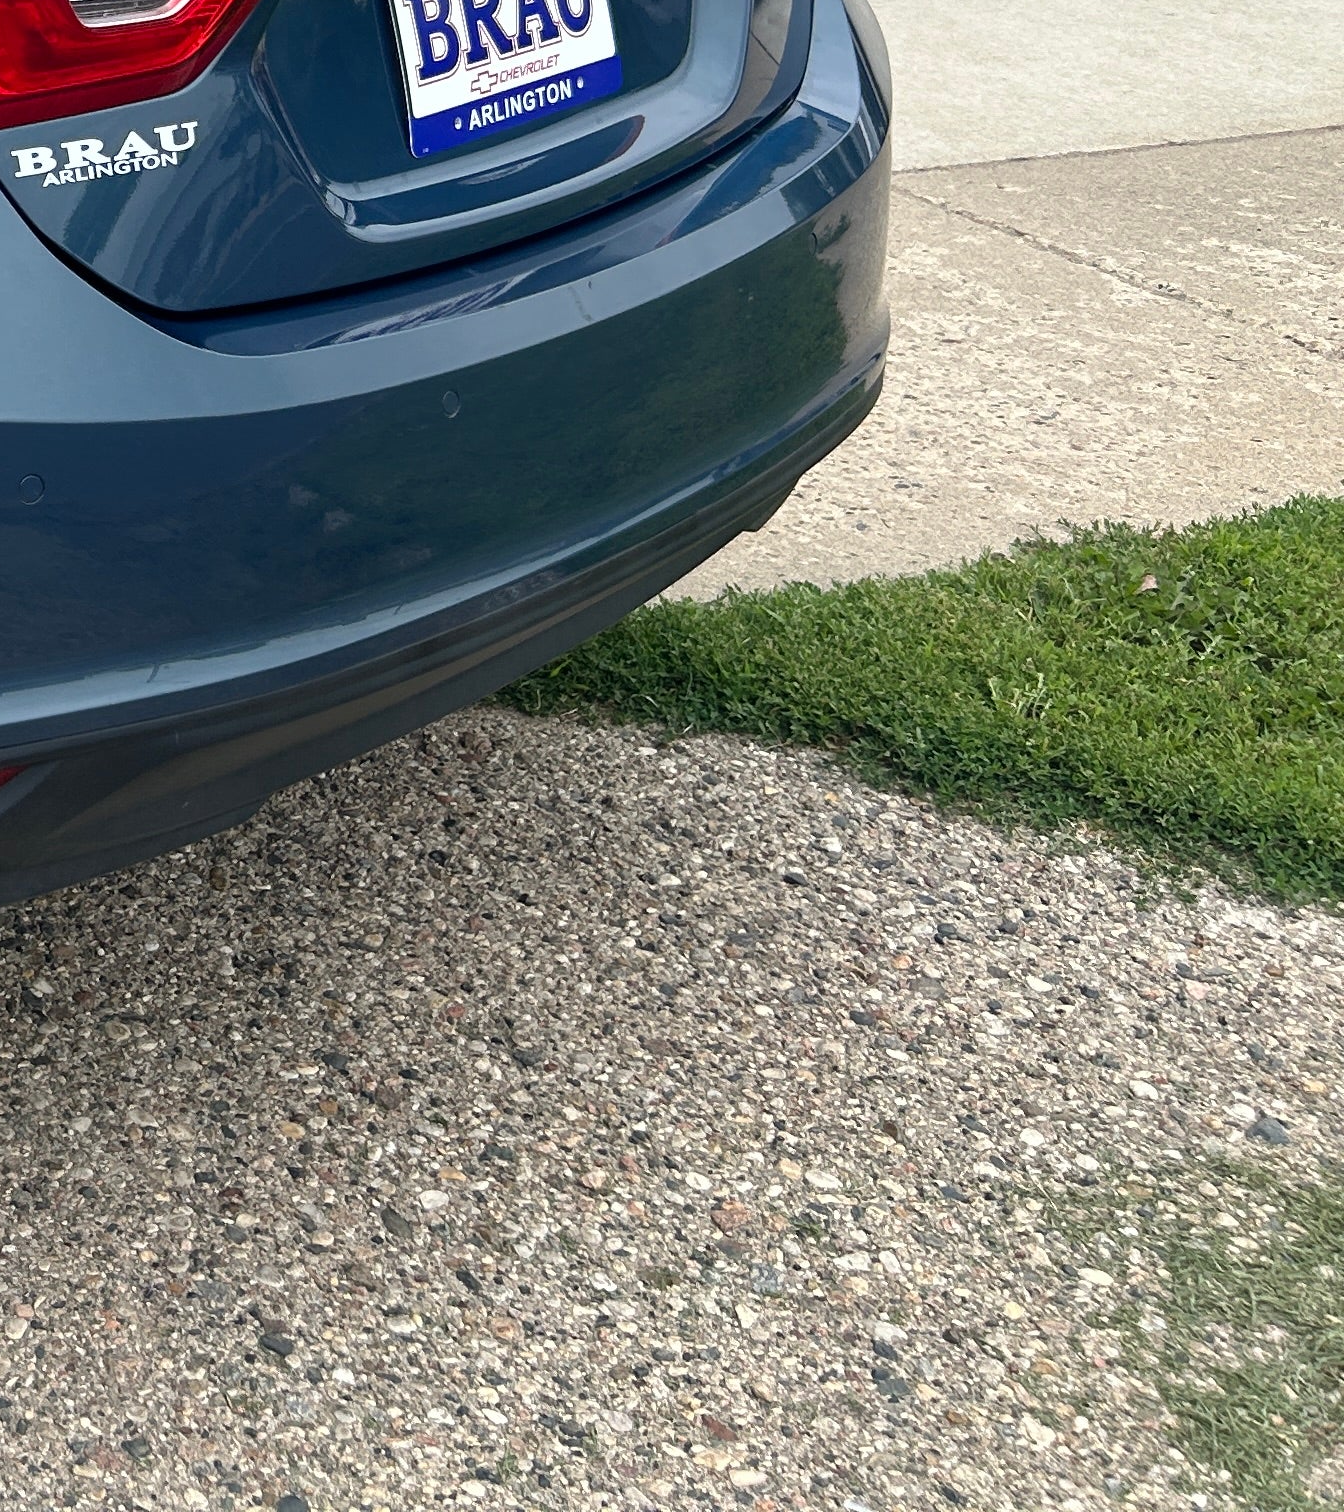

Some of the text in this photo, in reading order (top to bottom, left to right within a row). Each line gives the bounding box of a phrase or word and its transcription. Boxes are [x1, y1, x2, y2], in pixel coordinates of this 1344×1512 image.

[500, 54, 560, 83] CHEVROLET
[469, 79, 572, 131] ARLINGTON
[10, 121, 199, 178] BRAU
[41, 151, 178, 187] ARLINGTON
